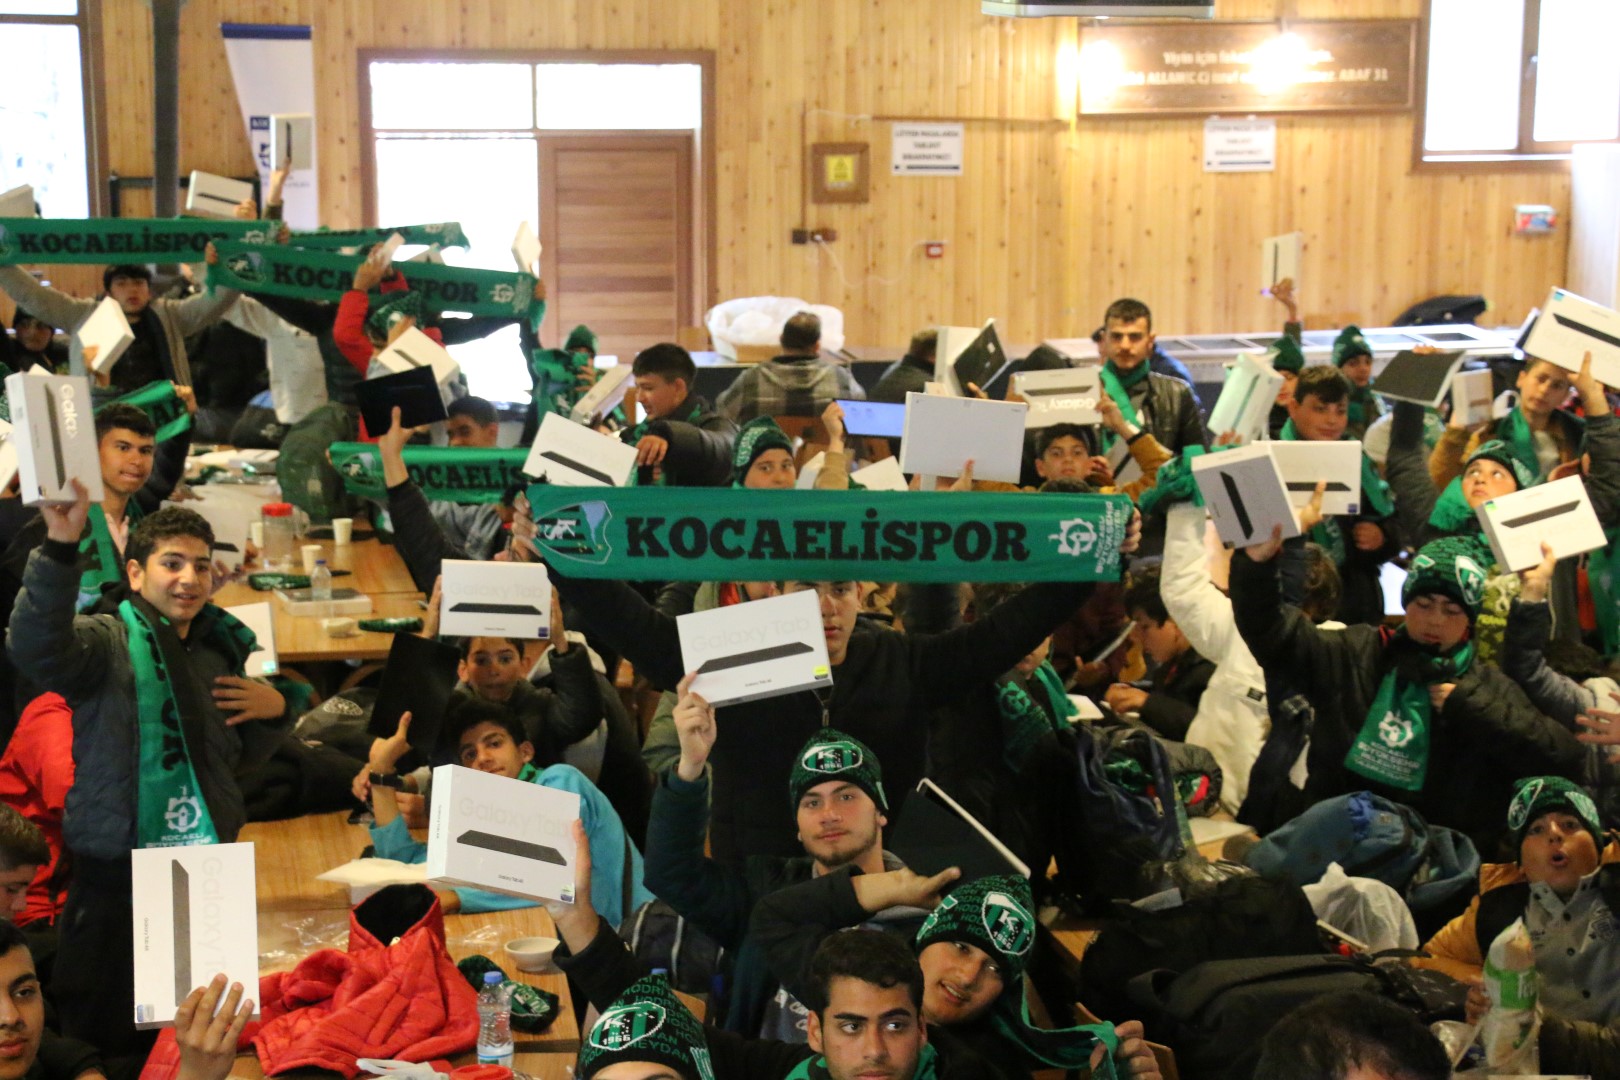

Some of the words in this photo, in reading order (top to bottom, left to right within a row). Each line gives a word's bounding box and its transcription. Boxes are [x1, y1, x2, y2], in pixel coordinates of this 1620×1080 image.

[18, 226, 229, 254] KOCAELİSPO
[274, 263, 479, 304] KOCAPOR
[625, 507, 1030, 562] KOCAELİSPOR
[691, 625, 766, 652] Galaxy
[772, 615, 810, 635] Tab
[459, 797, 531, 837] Galaxy
[199, 856, 225, 952] Galaxy
[998, 909, 1019, 932] K
[602, 1014, 627, 1032] K
[603, 1035, 631, 1046] 1966
